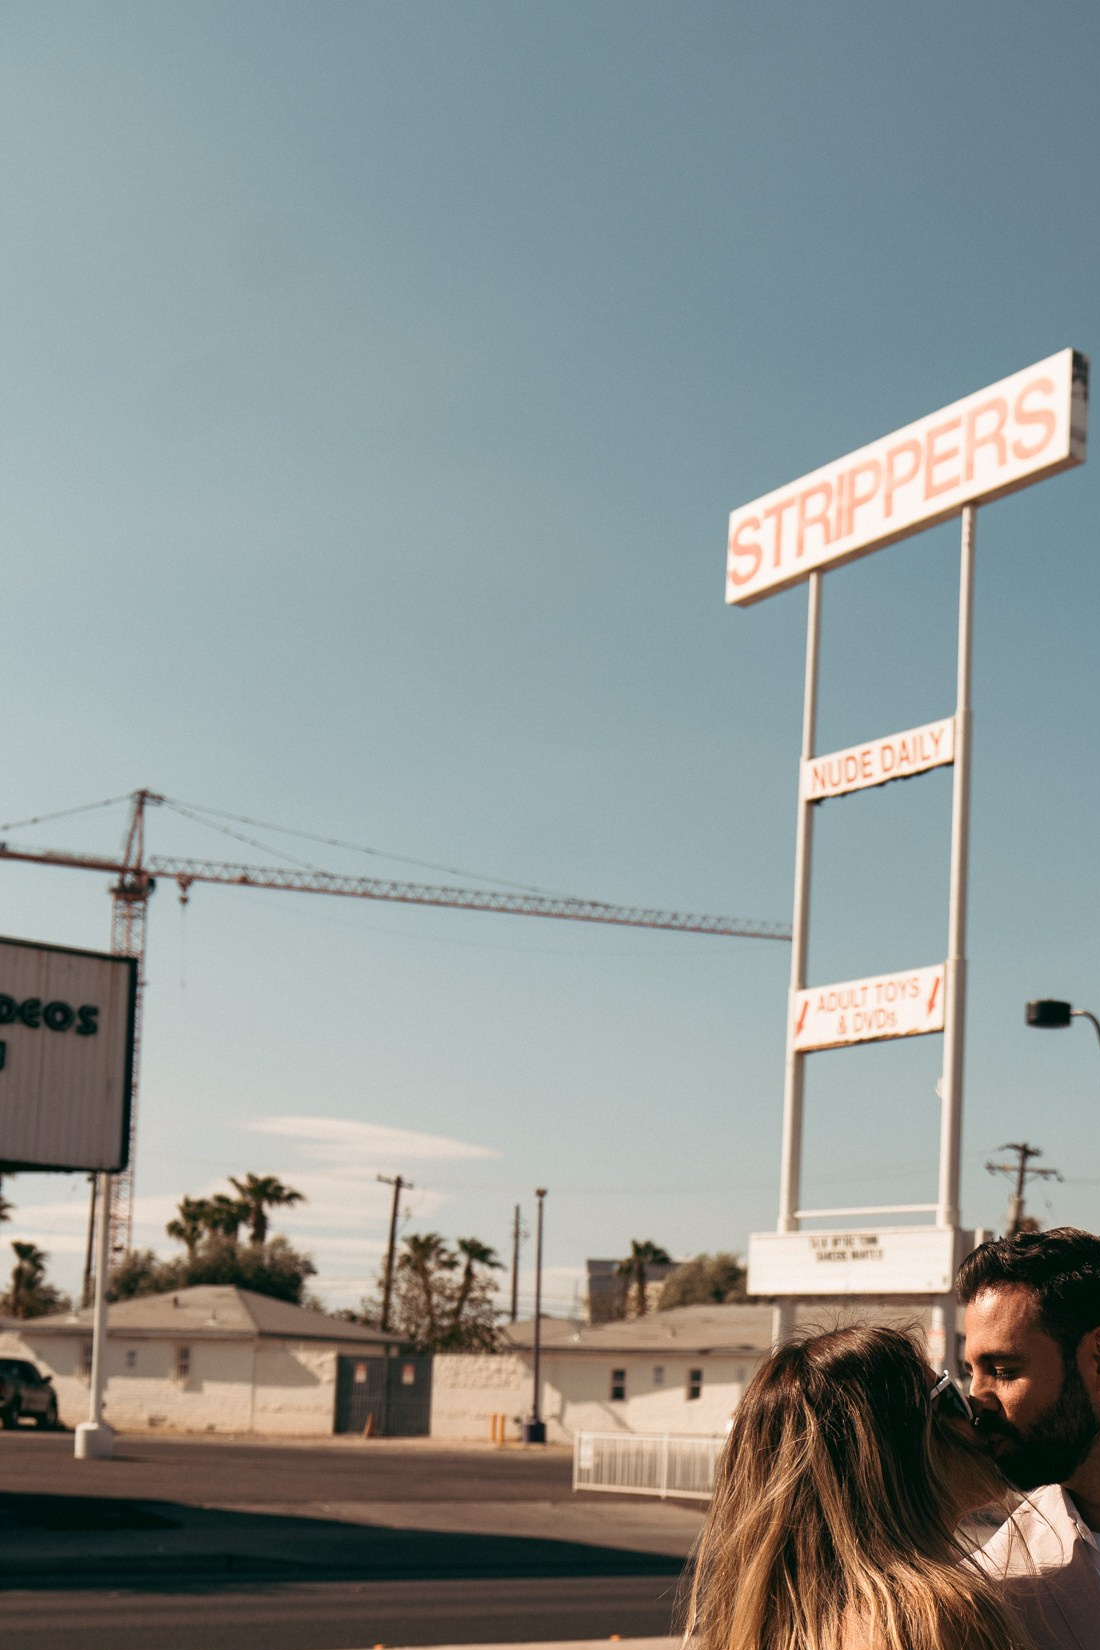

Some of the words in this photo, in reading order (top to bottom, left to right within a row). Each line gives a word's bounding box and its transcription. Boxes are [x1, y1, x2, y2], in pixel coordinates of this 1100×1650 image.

[728, 376, 1057, 586] STRIPPERS
[811, 750, 872, 791] NUDE
[880, 727, 945, 773] DAILY
[817, 986, 868, 1012] ADULT
[875, 977, 921, 1003] TOYS
[837, 1016, 847, 1034] &
